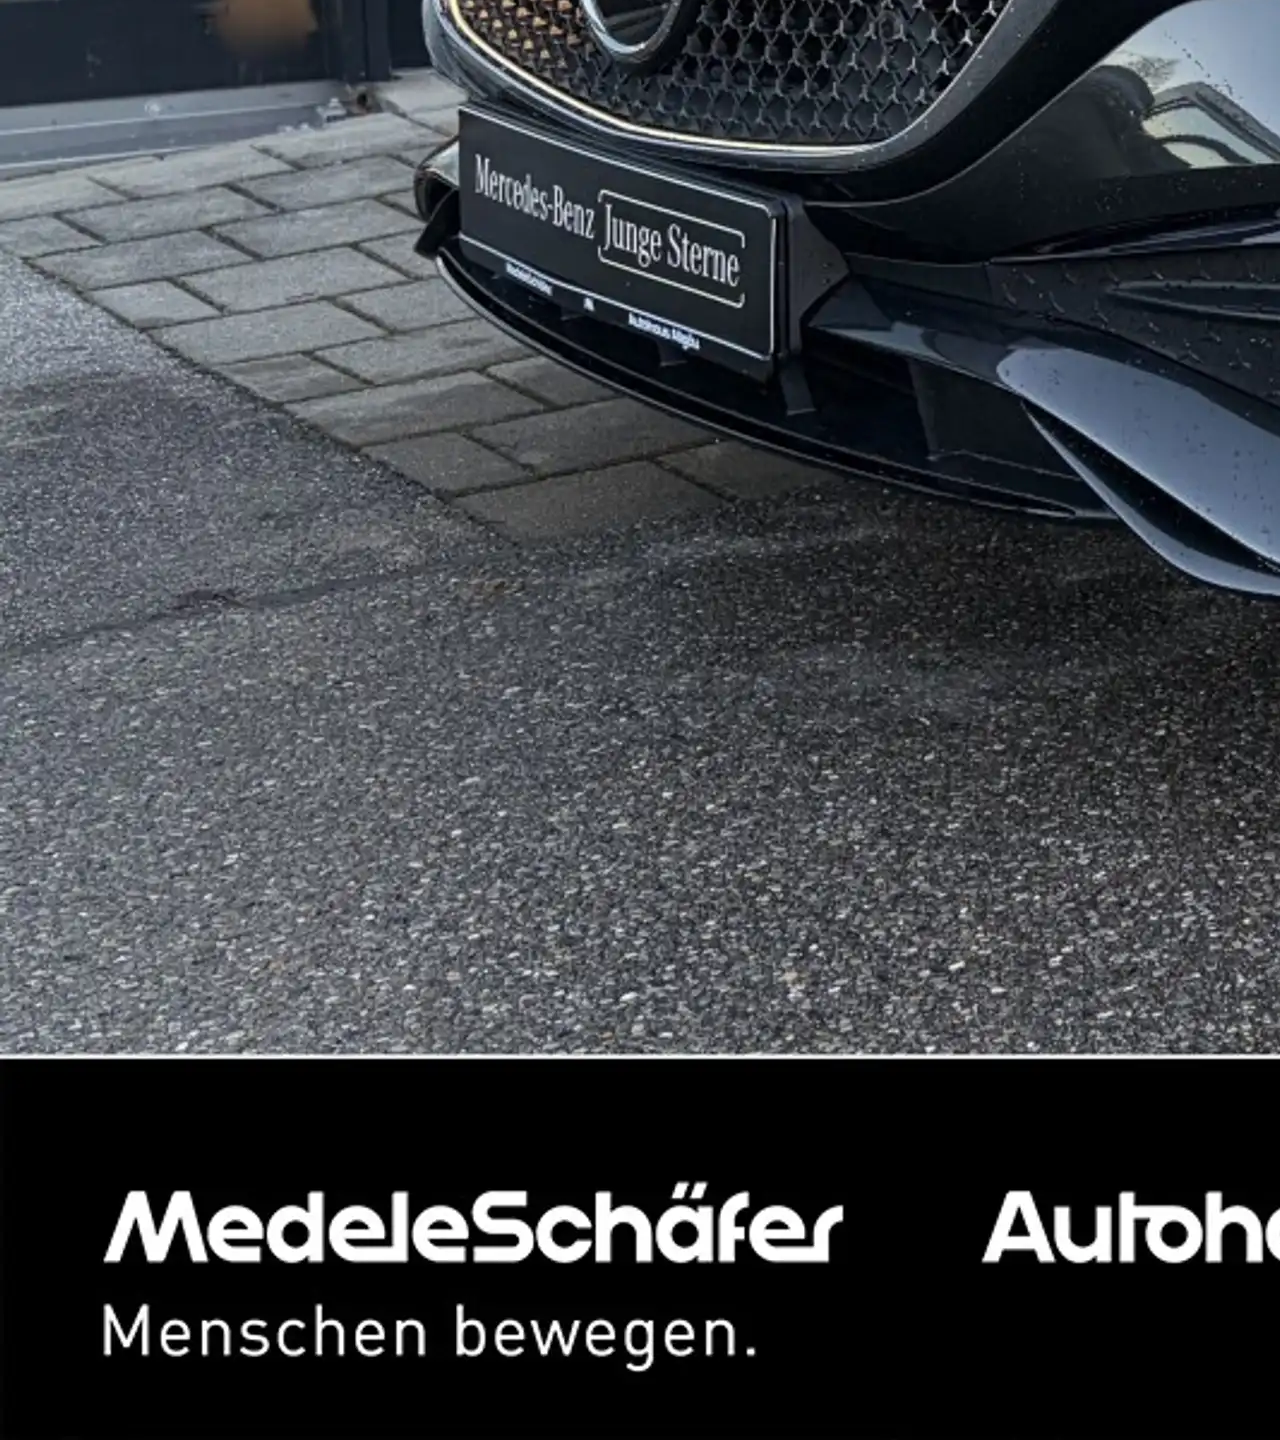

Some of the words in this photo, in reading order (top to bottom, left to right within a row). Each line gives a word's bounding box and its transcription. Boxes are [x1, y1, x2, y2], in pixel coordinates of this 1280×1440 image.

[474, 153, 596, 240] Mercedes-Benz
[602, 203, 662, 268] Junge
[667, 223, 740, 287] Sterne
